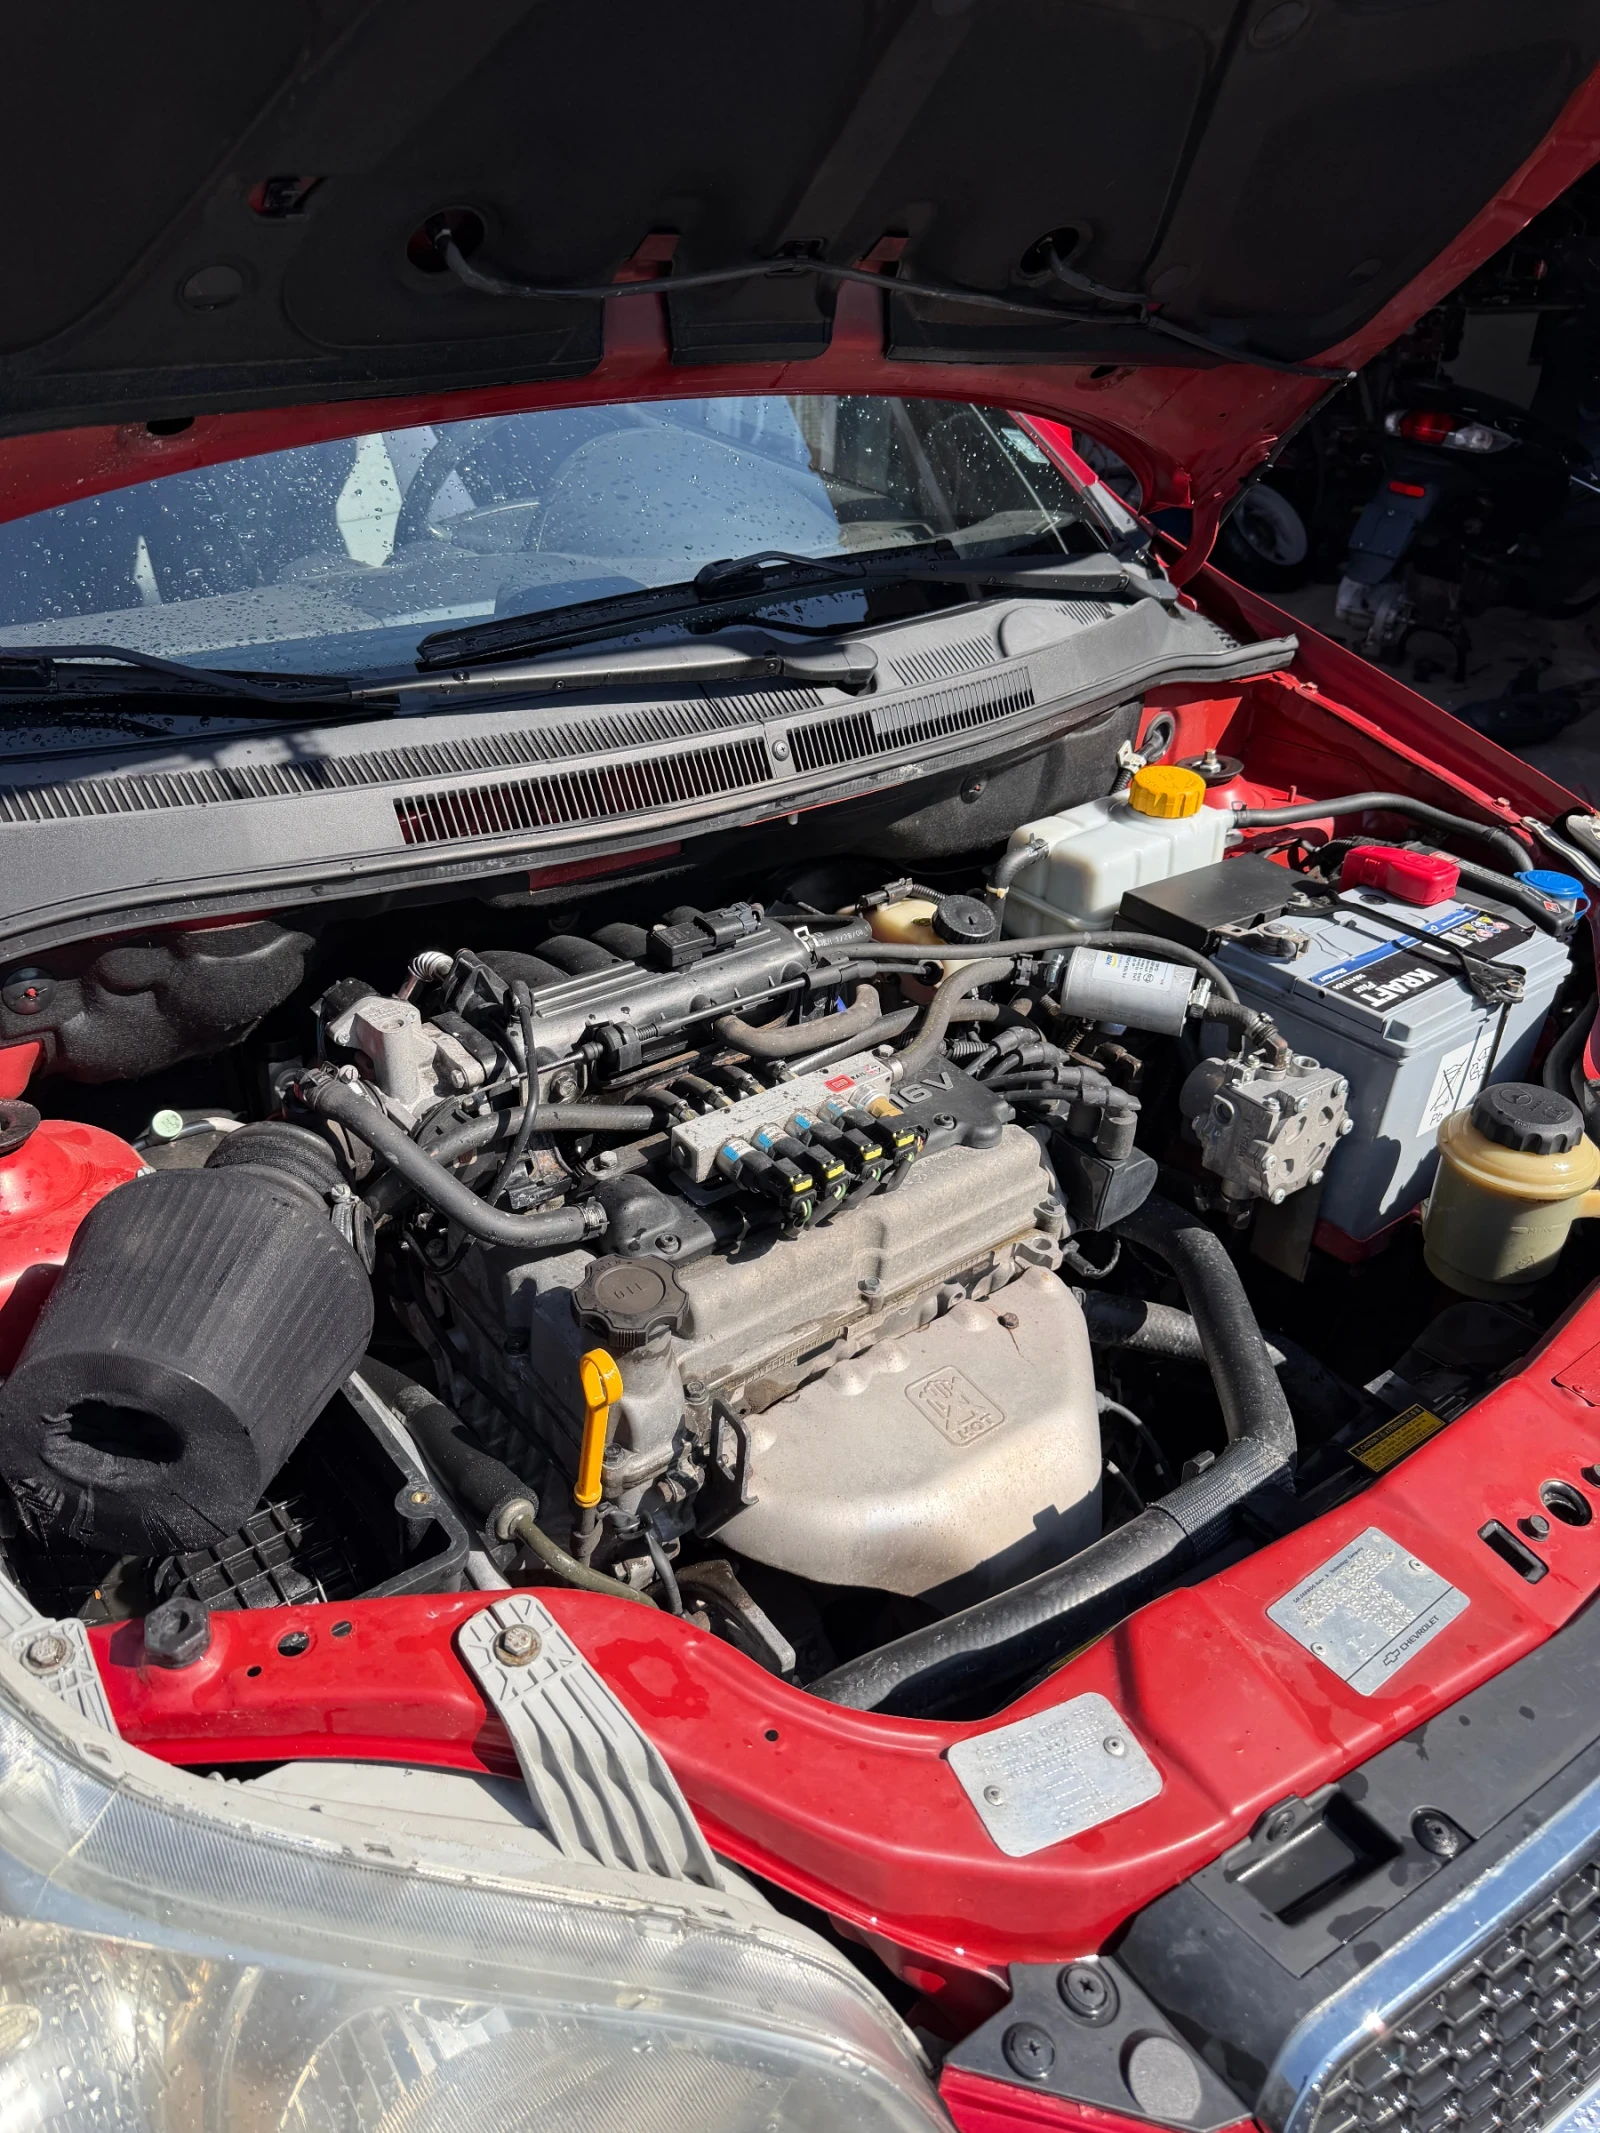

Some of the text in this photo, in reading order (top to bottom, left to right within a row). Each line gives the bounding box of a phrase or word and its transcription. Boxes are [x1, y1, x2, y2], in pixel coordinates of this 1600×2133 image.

[1353, 981, 1377, 993] Plus
[1360, 967, 1439, 1007] KRAFT
[889, 1071, 954, 1109] 16V
[613, 1282, 649, 1300] OIL
[1400, 1615, 1440, 1652] CHEVROLET
